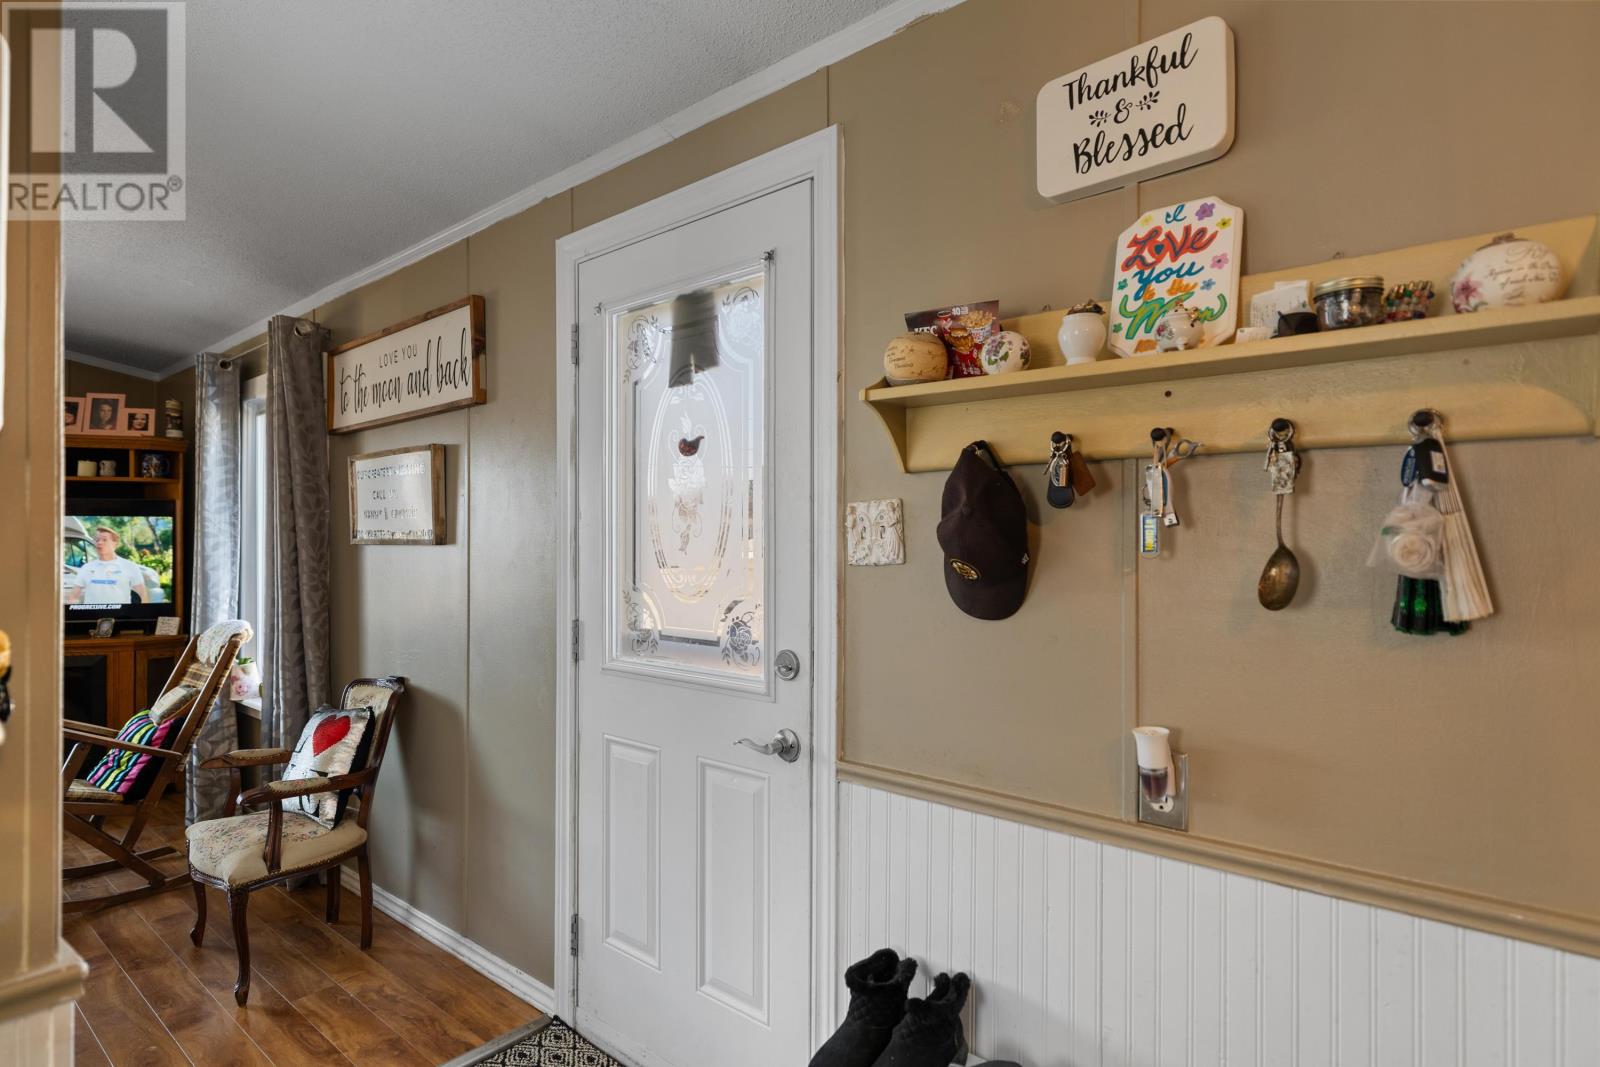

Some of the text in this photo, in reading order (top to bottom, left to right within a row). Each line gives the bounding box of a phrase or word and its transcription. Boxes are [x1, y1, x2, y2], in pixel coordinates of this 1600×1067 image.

[1062, 32, 1199, 110] Thankful
[1073, 103, 1194, 175] Blessed
[1113, 98, 1133, 124] &
[339, 327, 470, 416] to the moon and back
[379, 344, 418, 368] LOVE YOU
